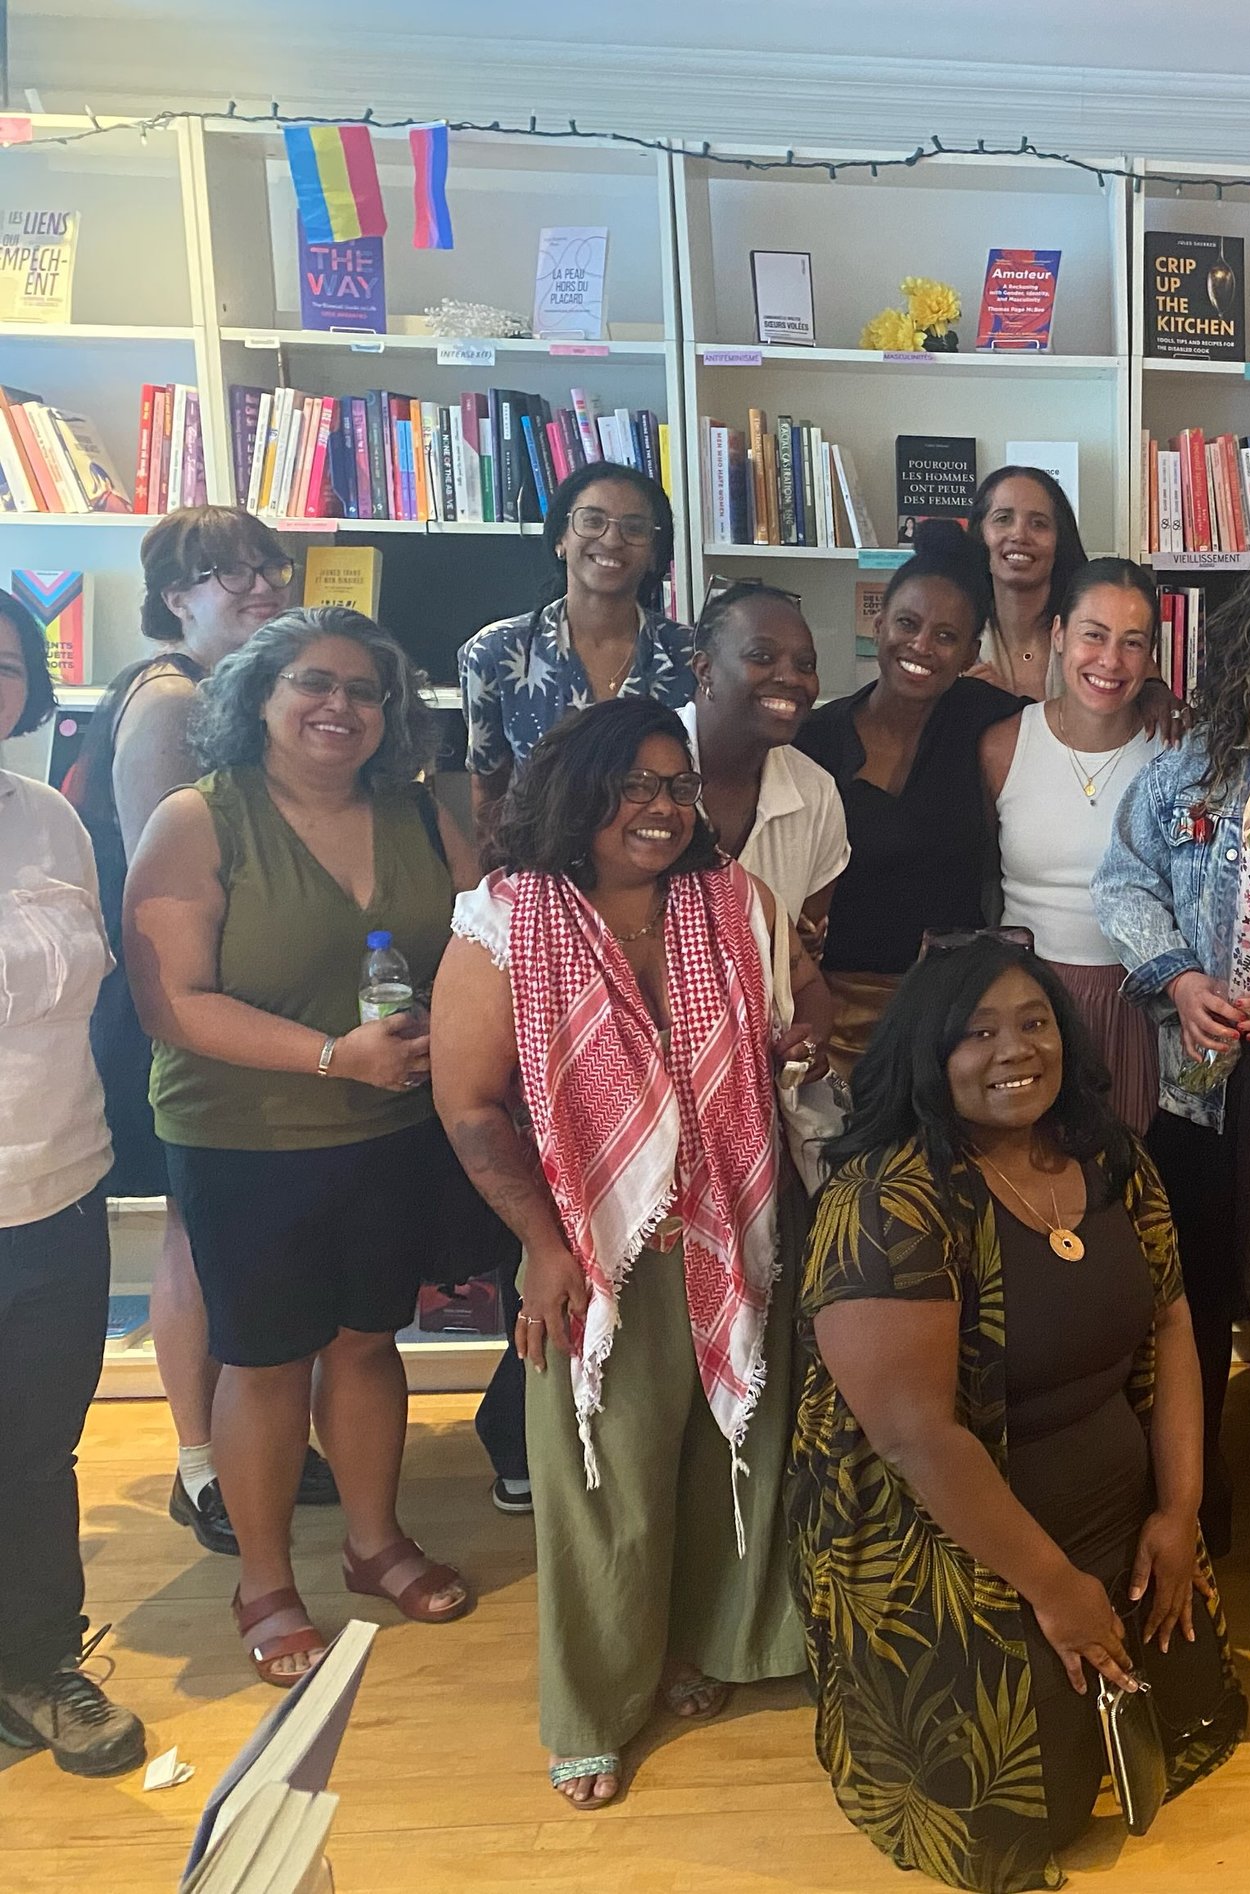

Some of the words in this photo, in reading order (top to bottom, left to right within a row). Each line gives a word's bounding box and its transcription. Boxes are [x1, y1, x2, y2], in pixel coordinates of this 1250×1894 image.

[8, 211, 22, 224] LES
[23, 211, 70, 235] LIENS
[3, 234, 20, 246] QUI
[0, 245, 68, 271] MPÊCH-
[310, 246, 374, 272] THE
[1155, 256, 1197, 274] CRIP
[552, 268, 562, 280] LA
[564, 268, 585, 280] PEAU
[992, 268, 1052, 280] Amateur
[25, 272, 59, 296] ENT
[307, 272, 379, 299] WAY
[555, 280, 576, 292] HORS
[577, 280, 589, 292] DU
[1156, 276, 1181, 293] UP
[550, 293, 584, 305] PLACARD
[1155, 296, 1189, 313] THE
[1157, 315, 1235, 336] KITCHEN
[780, 422, 790, 449] RACIAL
[442, 433, 452, 456] NONE
[908, 460, 967, 471] POURQUOI
[781, 451, 793, 503] CASTRATION
[902, 471, 922, 481] LES
[925, 472, 975, 483] HOMMES
[910, 484, 934, 494] ONT
[937, 484, 967, 494] PEUR
[904, 495, 925, 505] DES
[928, 496, 974, 506] FEMMES
[1173, 554, 1240, 564] VIEILLISSEMENT
